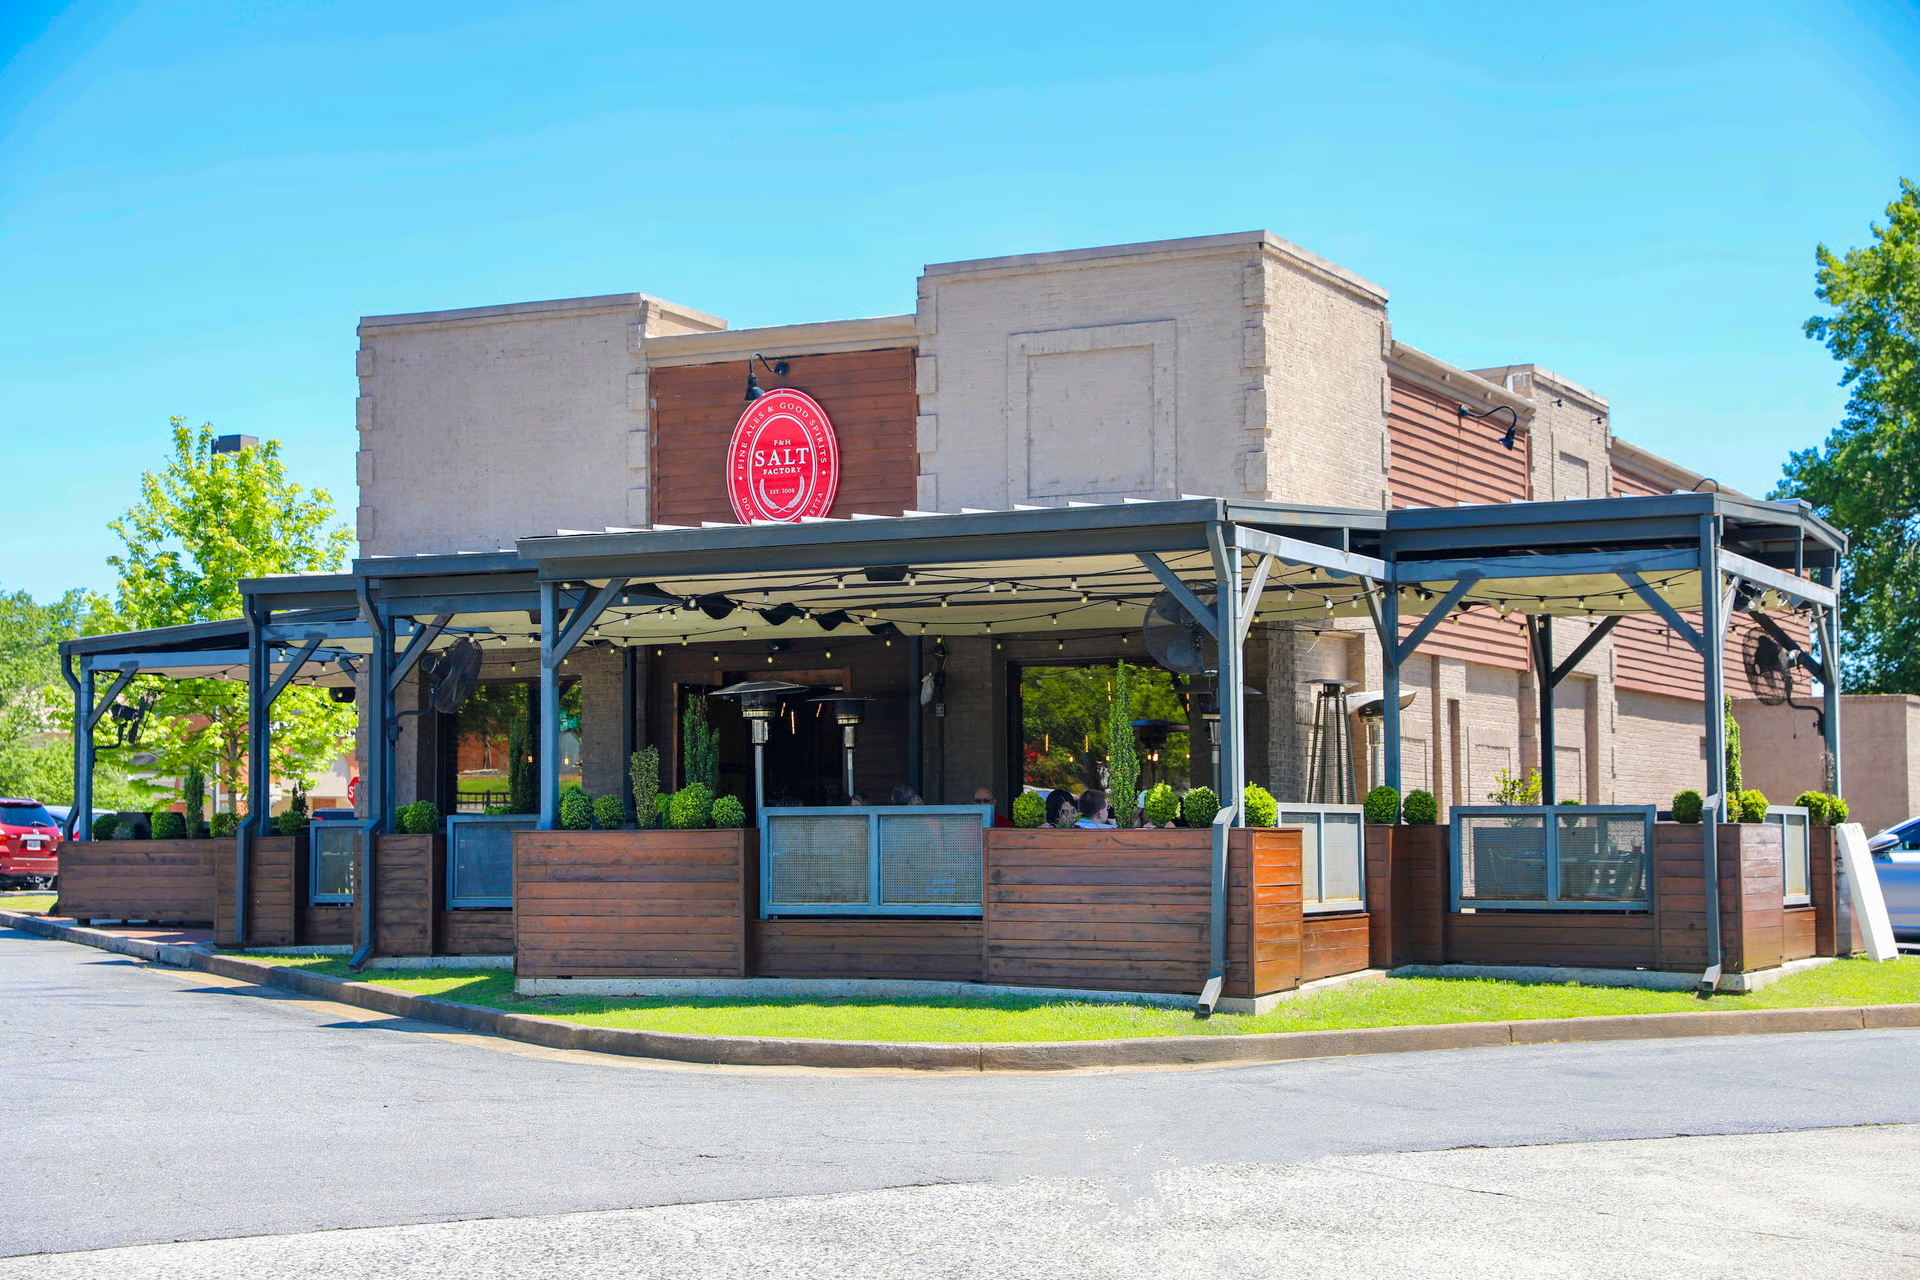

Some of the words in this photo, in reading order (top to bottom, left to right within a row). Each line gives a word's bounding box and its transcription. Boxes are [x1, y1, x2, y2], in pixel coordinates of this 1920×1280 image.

[738, 442, 748, 469] FINE
[746, 412, 764, 437] ALES
[779, 402, 809, 419] GOOD
[809, 419, 827, 464] SPIRITS
[755, 447, 809, 467] SALT
[763, 466, 802, 476] FACTORY
